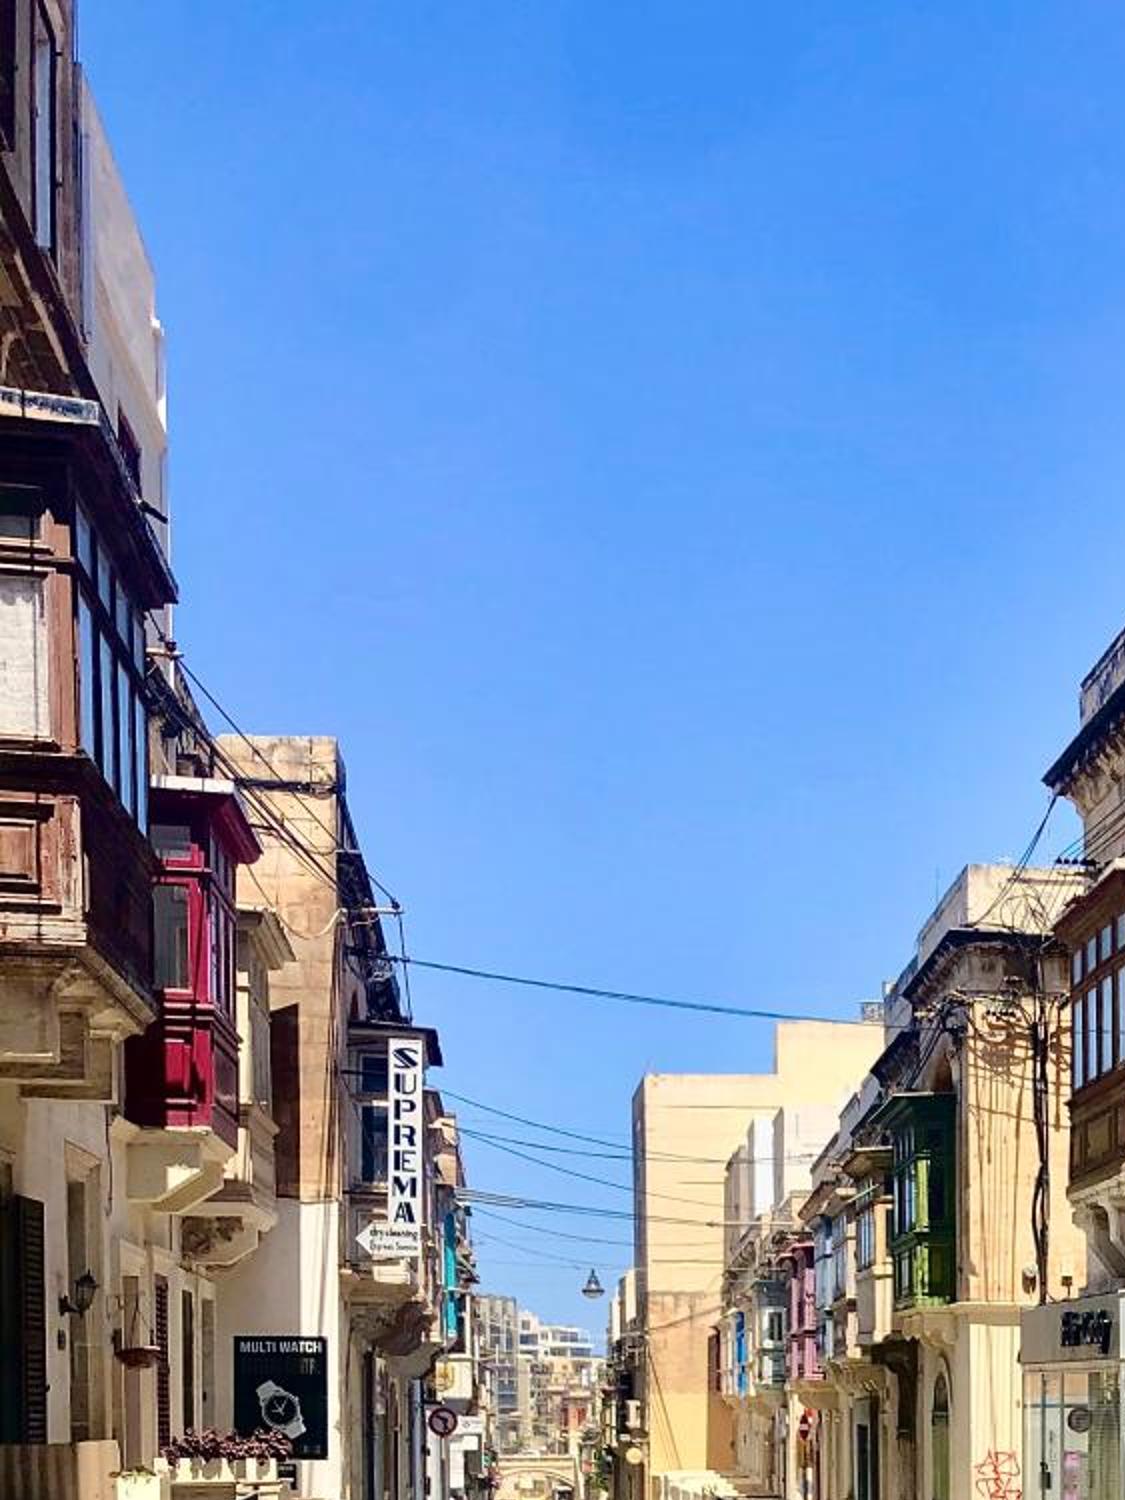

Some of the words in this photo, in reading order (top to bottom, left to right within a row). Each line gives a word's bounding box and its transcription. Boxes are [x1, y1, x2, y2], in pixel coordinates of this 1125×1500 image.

[392, 1047, 418, 1223] SUPREMA
[386, 1228, 418, 1241] cleaning
[240, 1341, 277, 1353] MULTI
[279, 1341, 322, 1353] WATCH
